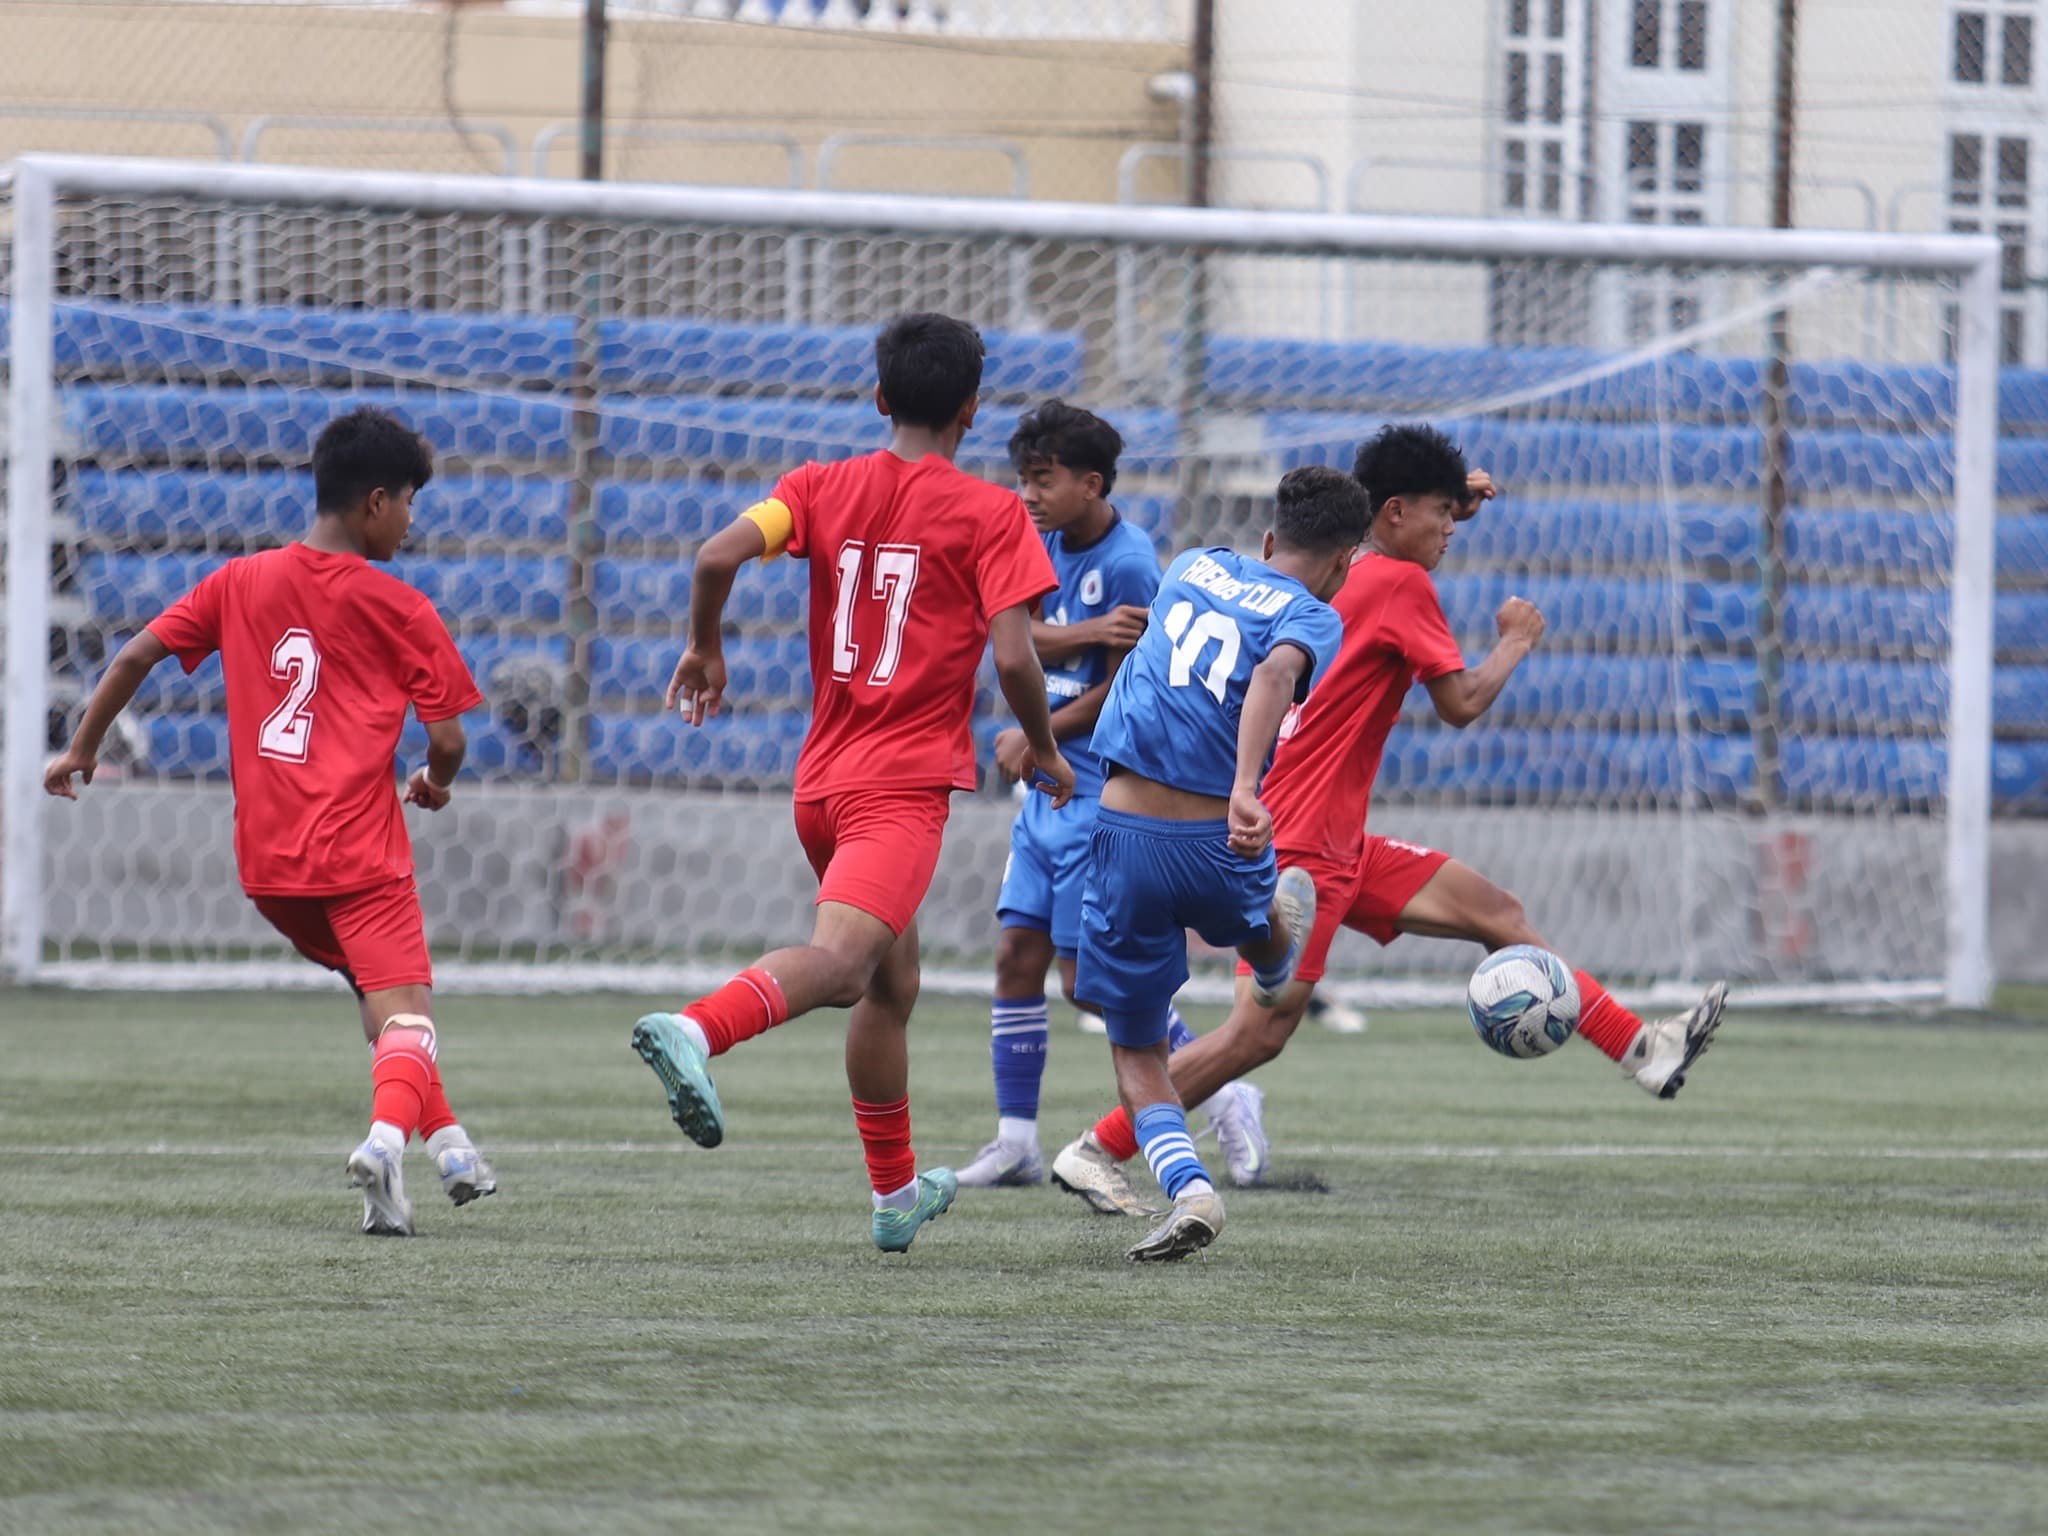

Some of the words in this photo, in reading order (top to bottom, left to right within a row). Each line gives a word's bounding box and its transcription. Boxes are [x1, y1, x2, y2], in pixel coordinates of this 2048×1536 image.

[832, 539, 920, 686] 17
[1239, 583, 1293, 616] CLUB
[258, 627, 321, 763] 2
